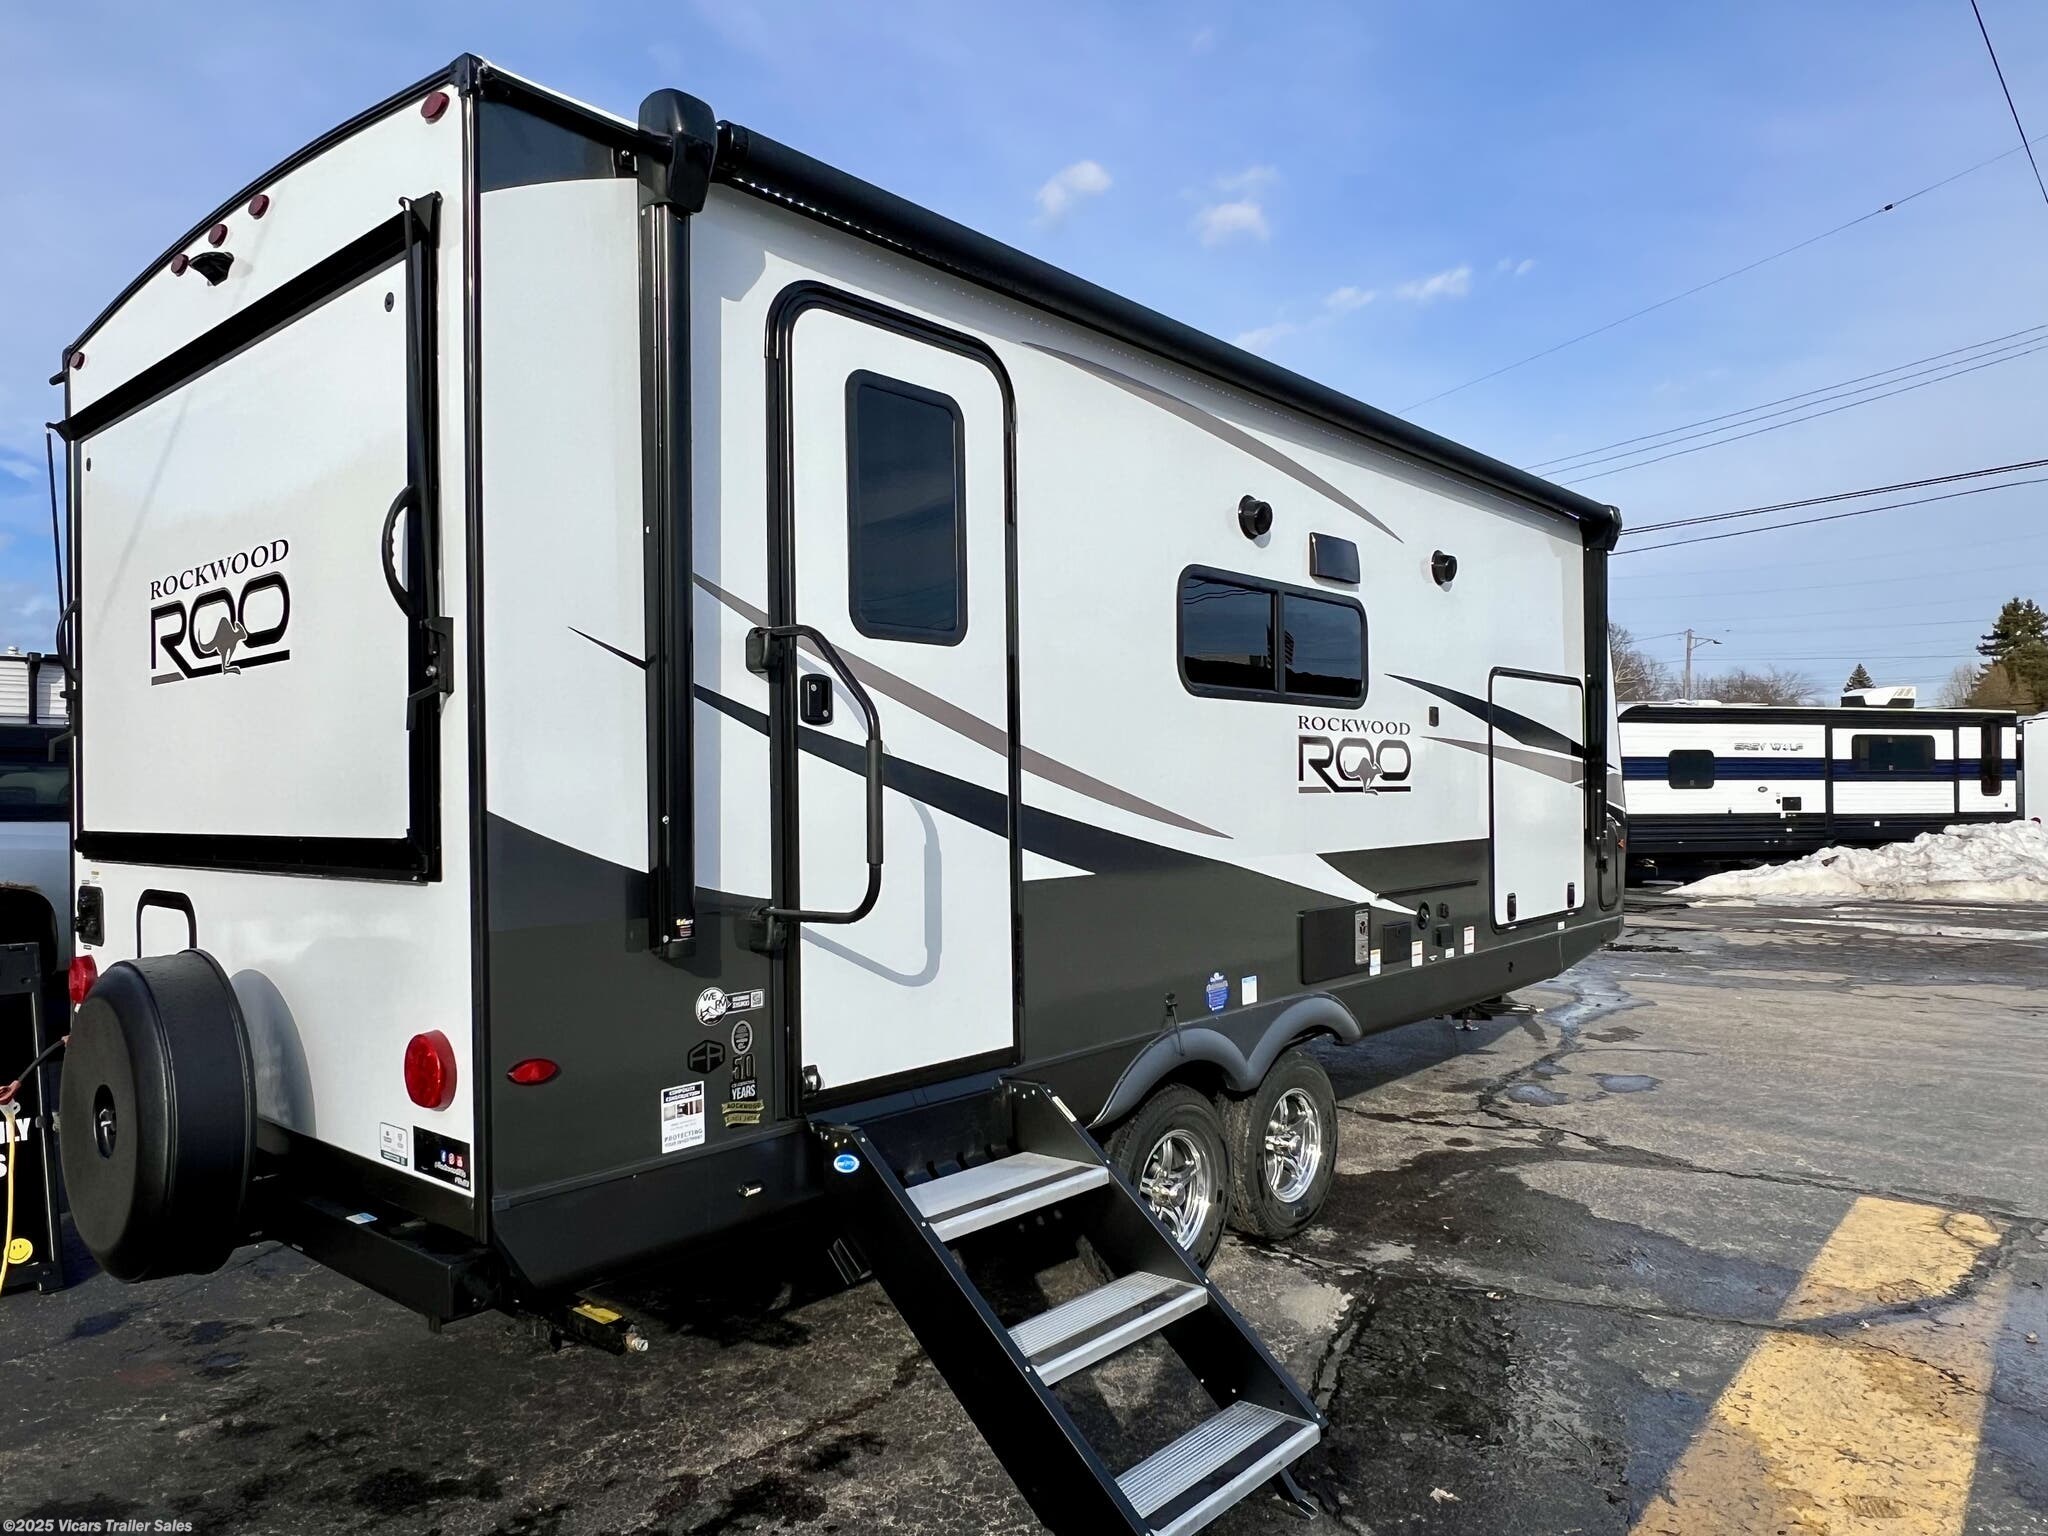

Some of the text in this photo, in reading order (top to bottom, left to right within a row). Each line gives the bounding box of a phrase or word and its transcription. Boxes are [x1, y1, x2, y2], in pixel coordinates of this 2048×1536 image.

[150, 539, 289, 600] ROCKWOOD
[150, 571, 291, 678] ROO
[1298, 715, 1411, 736] ROCKWOOD
[1298, 735, 1412, 793] ROO
[731, 1084, 756, 1100] YEARS
